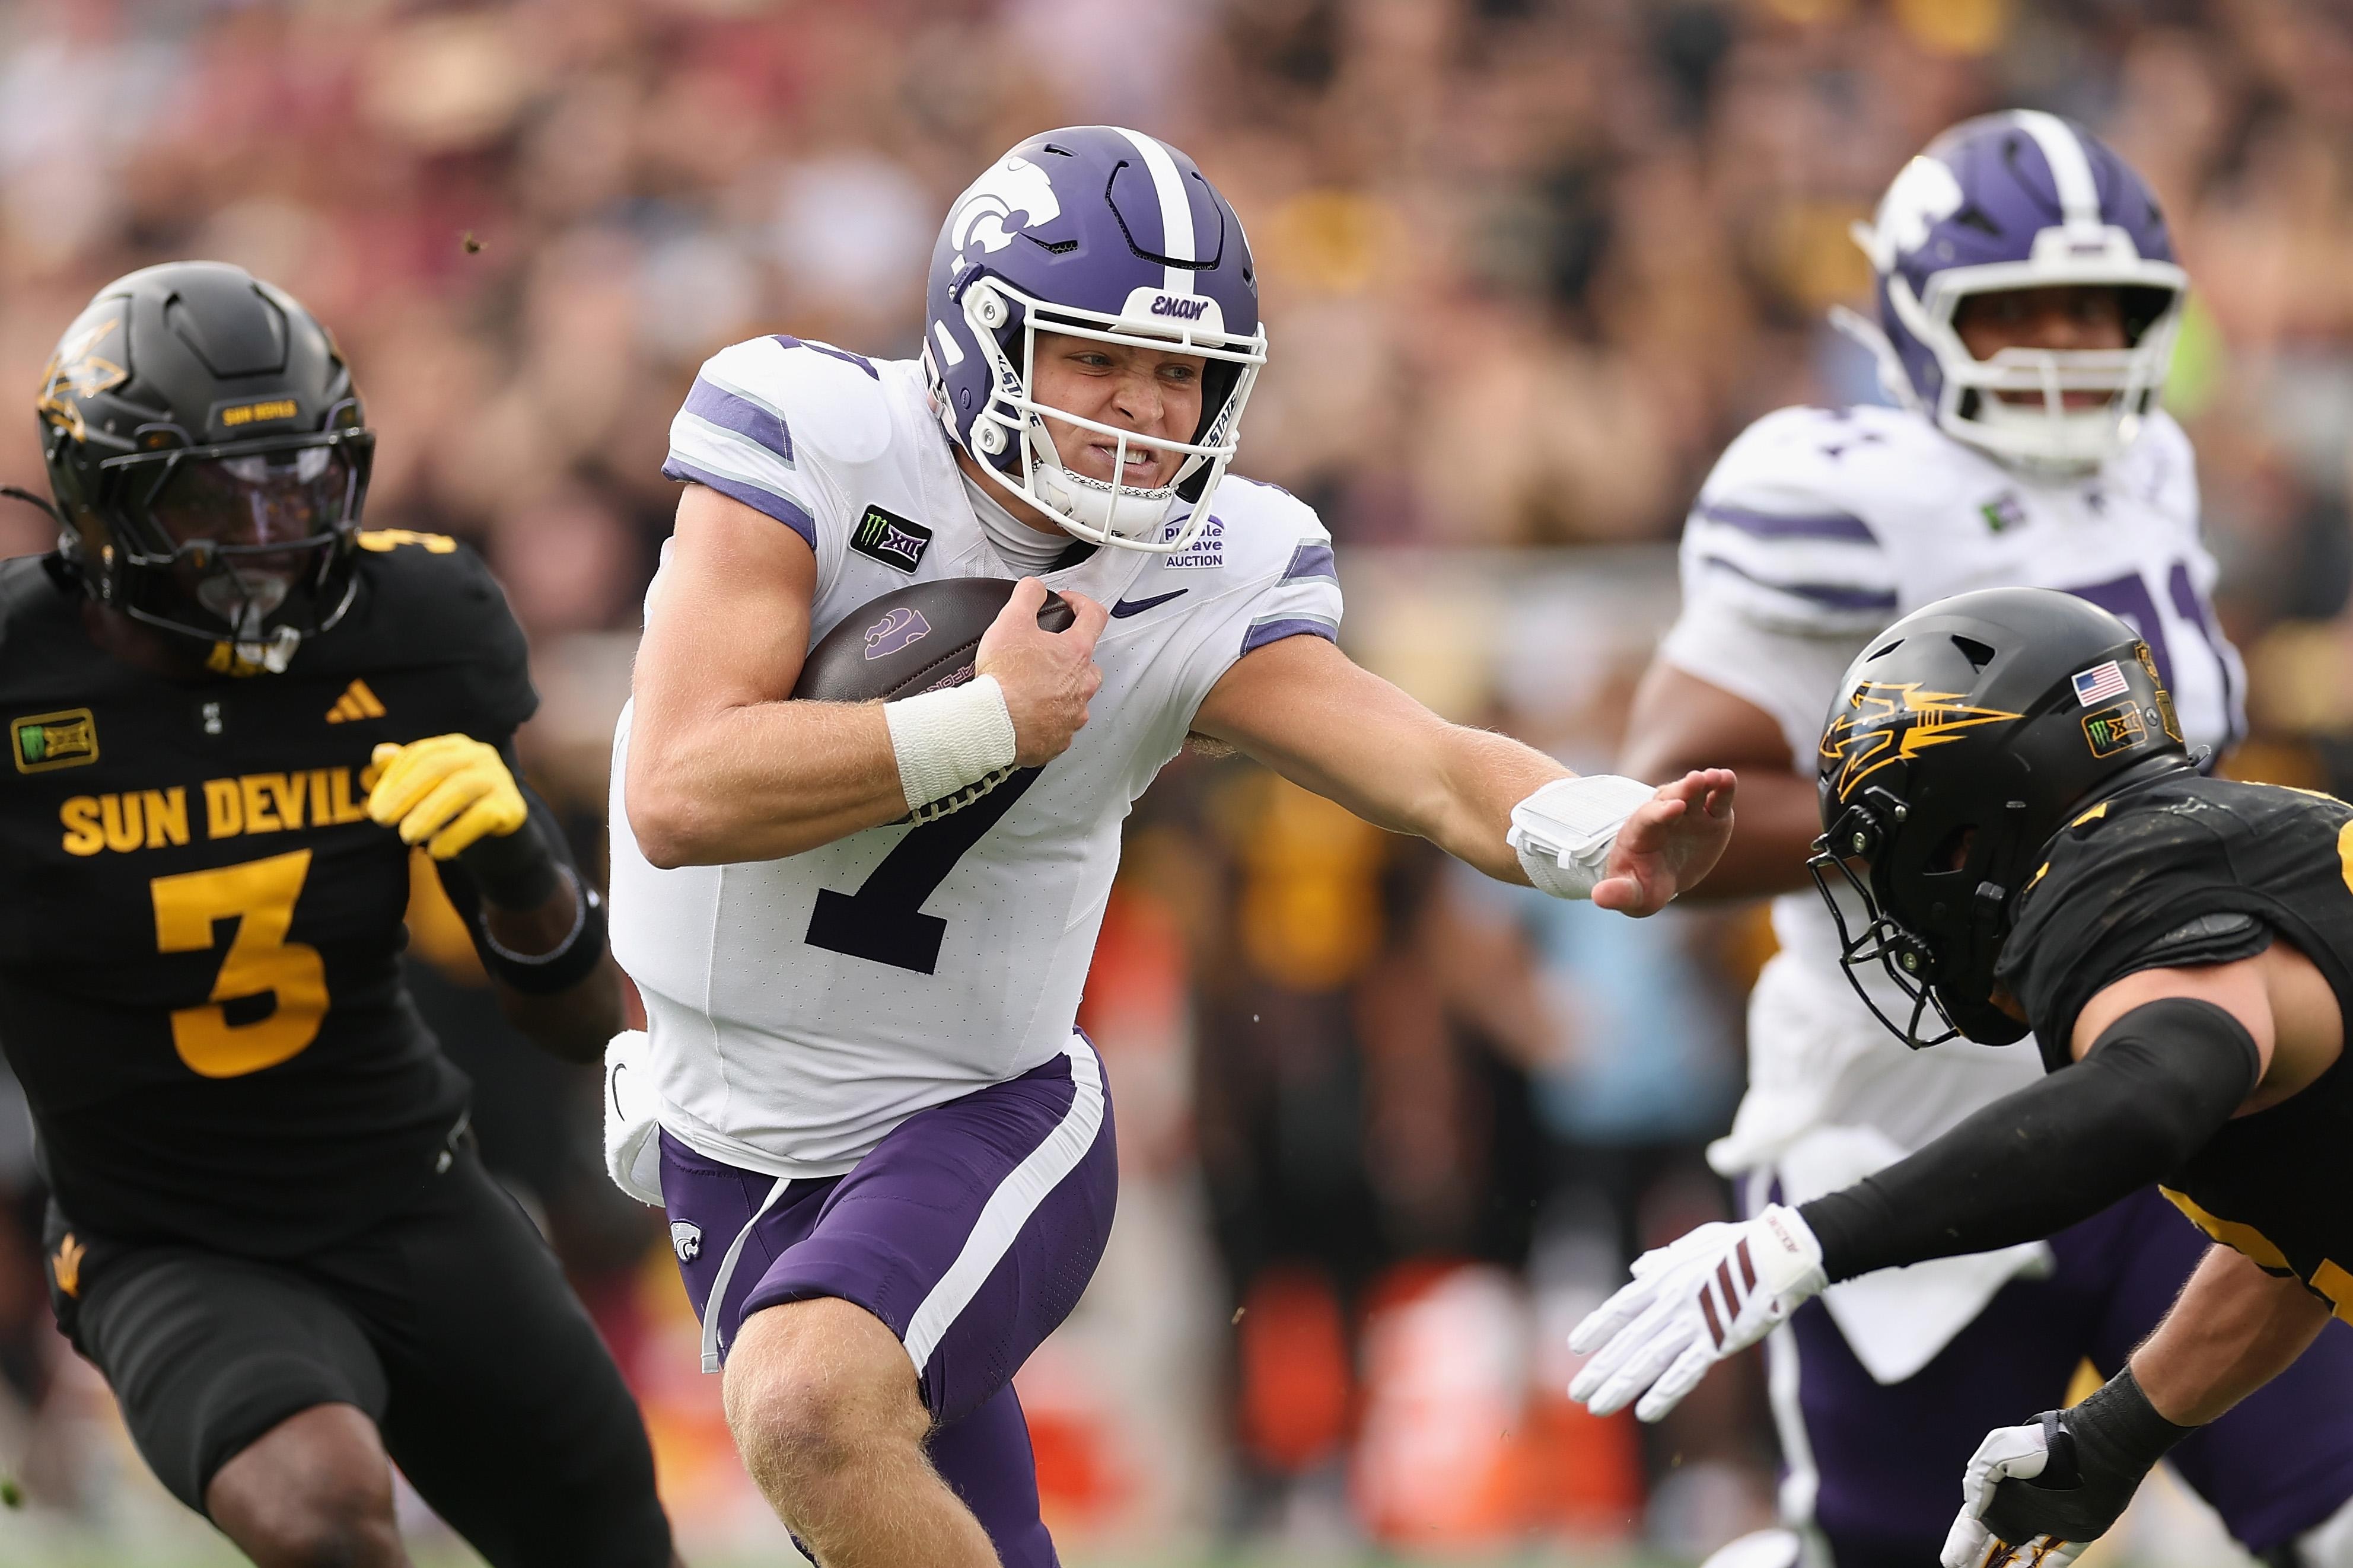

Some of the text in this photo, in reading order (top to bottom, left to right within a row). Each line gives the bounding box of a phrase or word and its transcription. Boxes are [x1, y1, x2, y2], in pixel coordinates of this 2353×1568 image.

[1151, 295, 1209, 321] EMAW
[998, 355, 1041, 427] K-STE
[1166, 555, 1223, 566] AUCTION
[1185, 541, 1223, 551] ave
[60, 786, 190, 856] SUN
[150, 848, 330, 1079] 3
